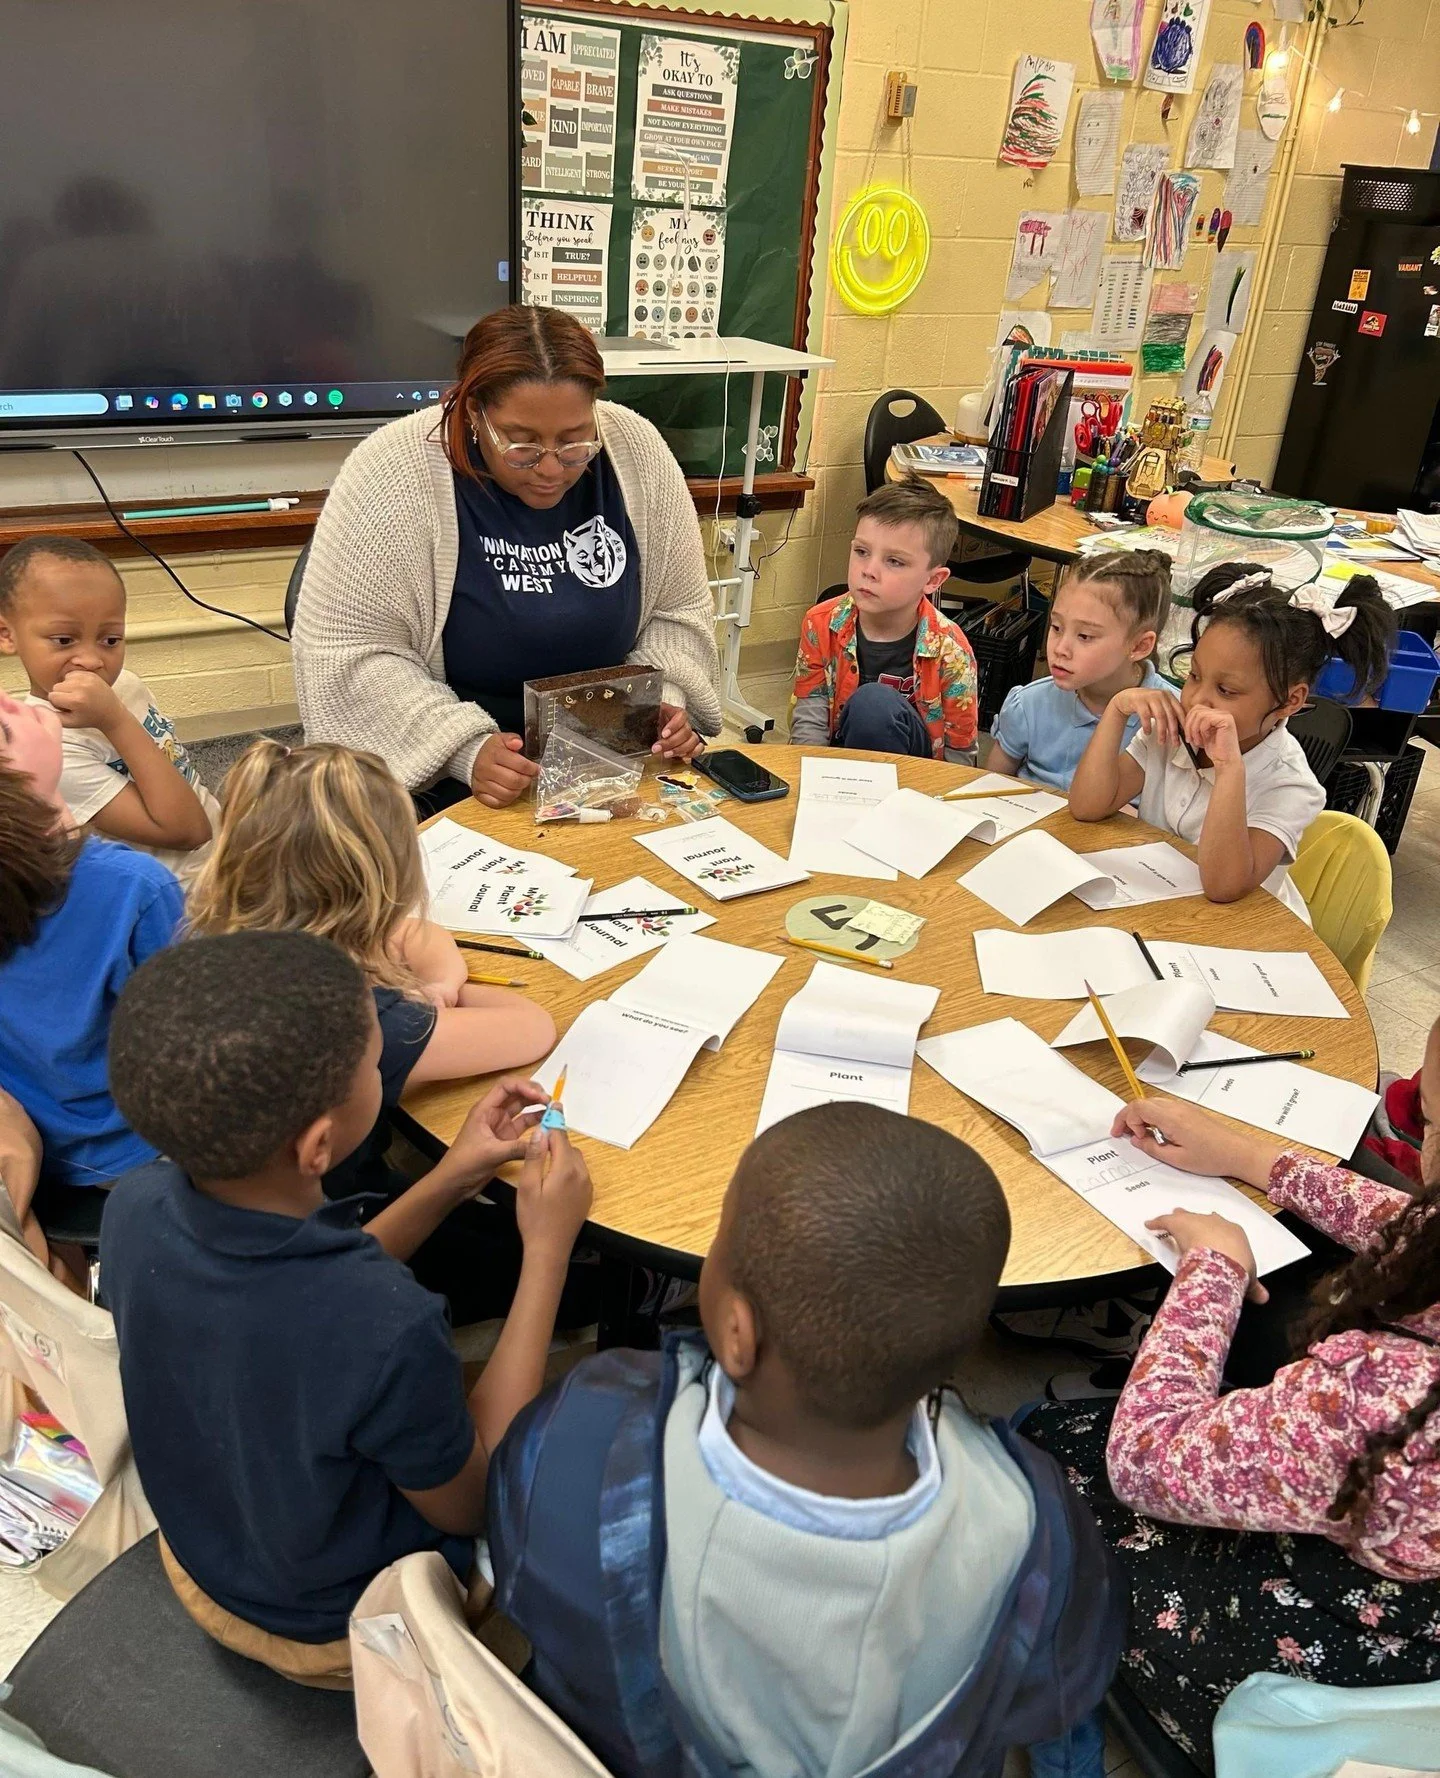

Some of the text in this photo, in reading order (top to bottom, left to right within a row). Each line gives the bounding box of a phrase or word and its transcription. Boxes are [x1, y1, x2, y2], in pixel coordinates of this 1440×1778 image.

[521, 27, 566, 54] I AM
[572, 44, 616, 60] APPRECIATED
[522, 68, 614, 98] OVED CAPABLE BRAVE
[662, 68, 713, 86] OKAY TO
[662, 88, 712, 101] ASK QUESTIONS
[660, 104, 712, 117] MAKE MISTAKES
[551, 119, 612, 134] KIND IMPORTANT
[648, 117, 722, 133] NOT KNOW EVERYTHING
[673, 136, 690, 144] YOUR
[706, 140, 722, 148] PACE
[522, 156, 610, 180] EARD INTELLIGENT STRONG
[657, 165, 675, 173] SEEK
[668, 181, 700, 190] YOURELF
[526, 211, 595, 231] THINK
[525, 230, 594, 246] Before you speak
[659, 231, 700, 254] feelngs
[565, 252, 590, 260] TRUE?
[557, 273, 597, 282] HELPFUL?
[555, 295, 599, 304] INSPIRING?
[486, 556, 567, 576] CAEMY
[502, 574, 553, 594] WEST
[450, 848, 486, 870] Journa
[683, 846, 726, 862] Journal
[710, 855, 742, 866] Plant
[478, 856, 507, 872] Plant
[506, 860, 525, 871] My
[468, 884, 491, 912] Journal
[497, 885, 516, 905] Plant
[522, 887, 539, 899] My
[584, 922, 628, 948] Journal
[1168, 962, 1183, 978] Plant
[622, 1013, 643, 1021] What
[829, 1072, 864, 1081] Plant
[1221, 1078, 1235, 1092] Seeds
[1276, 1114, 1286, 1126] How
[1283, 1104, 1291, 1115] will
[1290, 1088, 1300, 1104] grow?
[1087, 1150, 1119, 1165] Plant
[1125, 1180, 1151, 1192] Seeds
